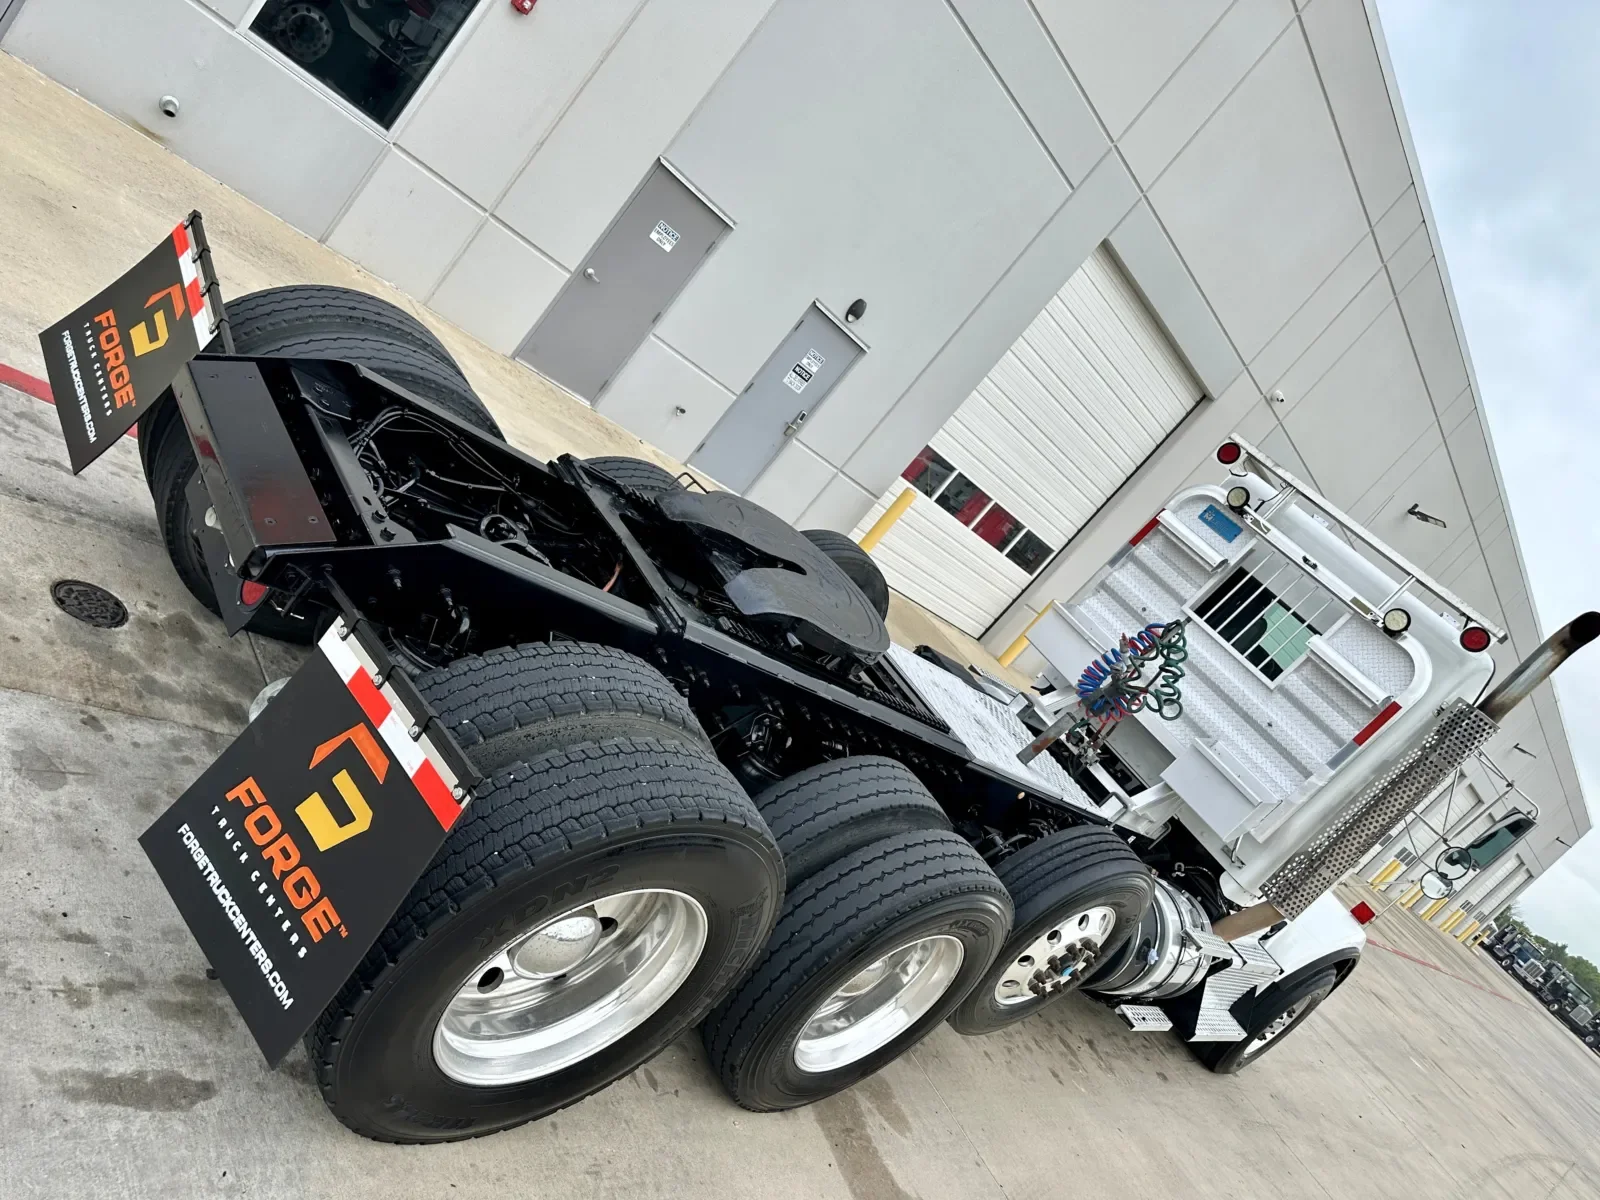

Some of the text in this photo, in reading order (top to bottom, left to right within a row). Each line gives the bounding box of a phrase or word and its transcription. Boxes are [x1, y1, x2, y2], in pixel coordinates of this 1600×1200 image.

[61, 329, 98, 444] FORGETRUCKCENTERS.COM
[83, 322, 113, 417] TRUCK CENTERS
[177, 823, 294, 1011] FORGETRUCKCENTERS.COM
[210, 805, 308, 959] TRUCK CENTERS
[225, 776, 341, 943] FORGE
